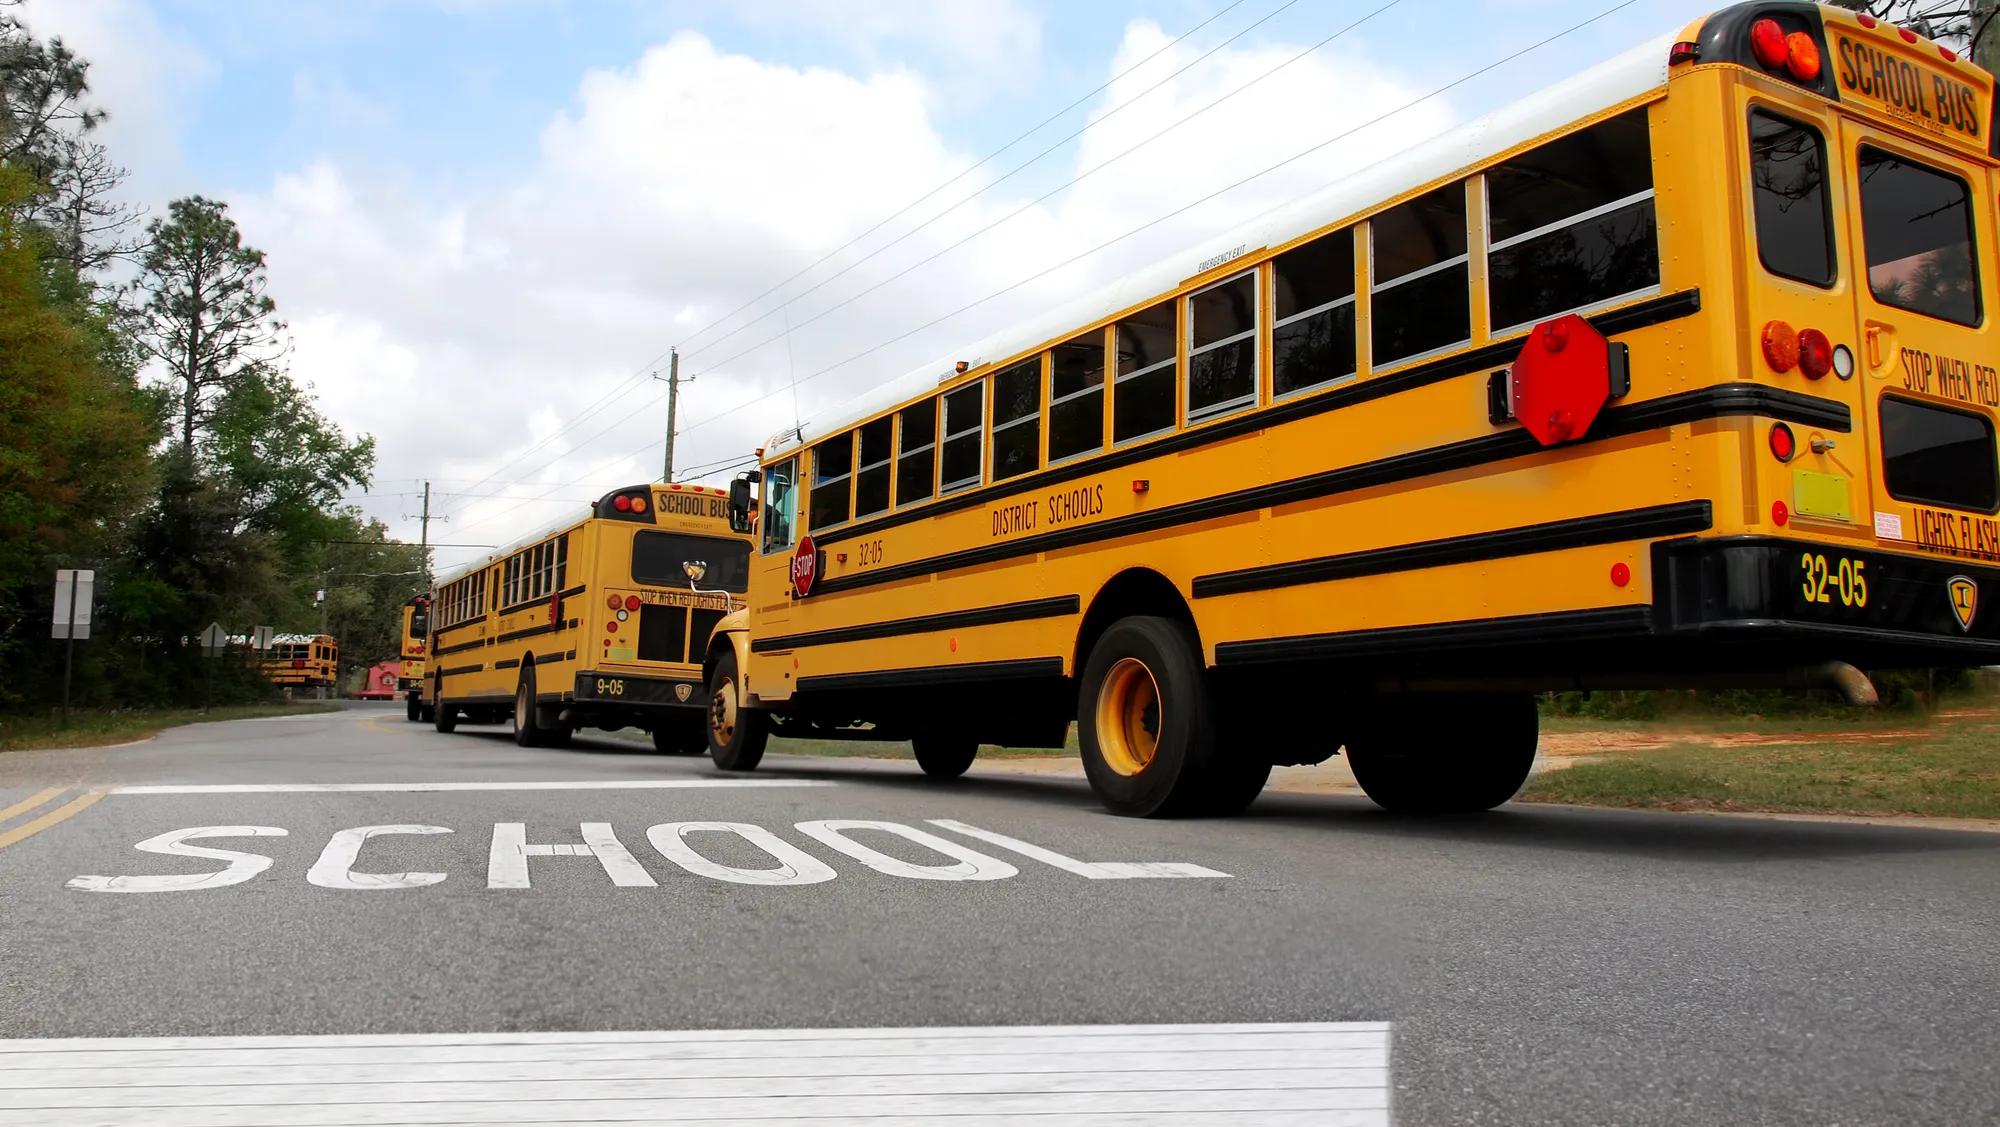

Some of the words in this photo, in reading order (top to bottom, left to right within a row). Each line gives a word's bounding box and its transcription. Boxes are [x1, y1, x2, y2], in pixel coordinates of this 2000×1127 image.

[1839, 36, 1931, 118] SCHOOL
[1933, 74, 1978, 136] BUS
[1198, 250, 1232, 272] EMERGENCY
[1232, 244, 1246, 258] EXIT
[1901, 347, 1932, 393] STOP
[1935, 355, 1972, 402] WHEN
[1975, 364, 1999, 407] RED
[660, 493, 706, 516] SCHOOL
[993, 501, 1038, 536] DISTRICT
[1049, 484, 1103, 525] SCHOOLS
[859, 540, 883, 567] 32-05
[1913, 507, 1958, 556] LIGHTS
[1960, 515, 2000, 561] FLASH
[797, 554, 813, 578] STOP
[1802, 553, 1867, 608] 32-05
[640, 588, 656, 604] STOP
[659, 590, 677, 606] WHEN
[679, 592, 691, 607] RED
[693, 593, 715, 609] LIGHTS
[597, 678, 624, 695] 9-05
[64, 819, 1234, 893] SCHOOL
